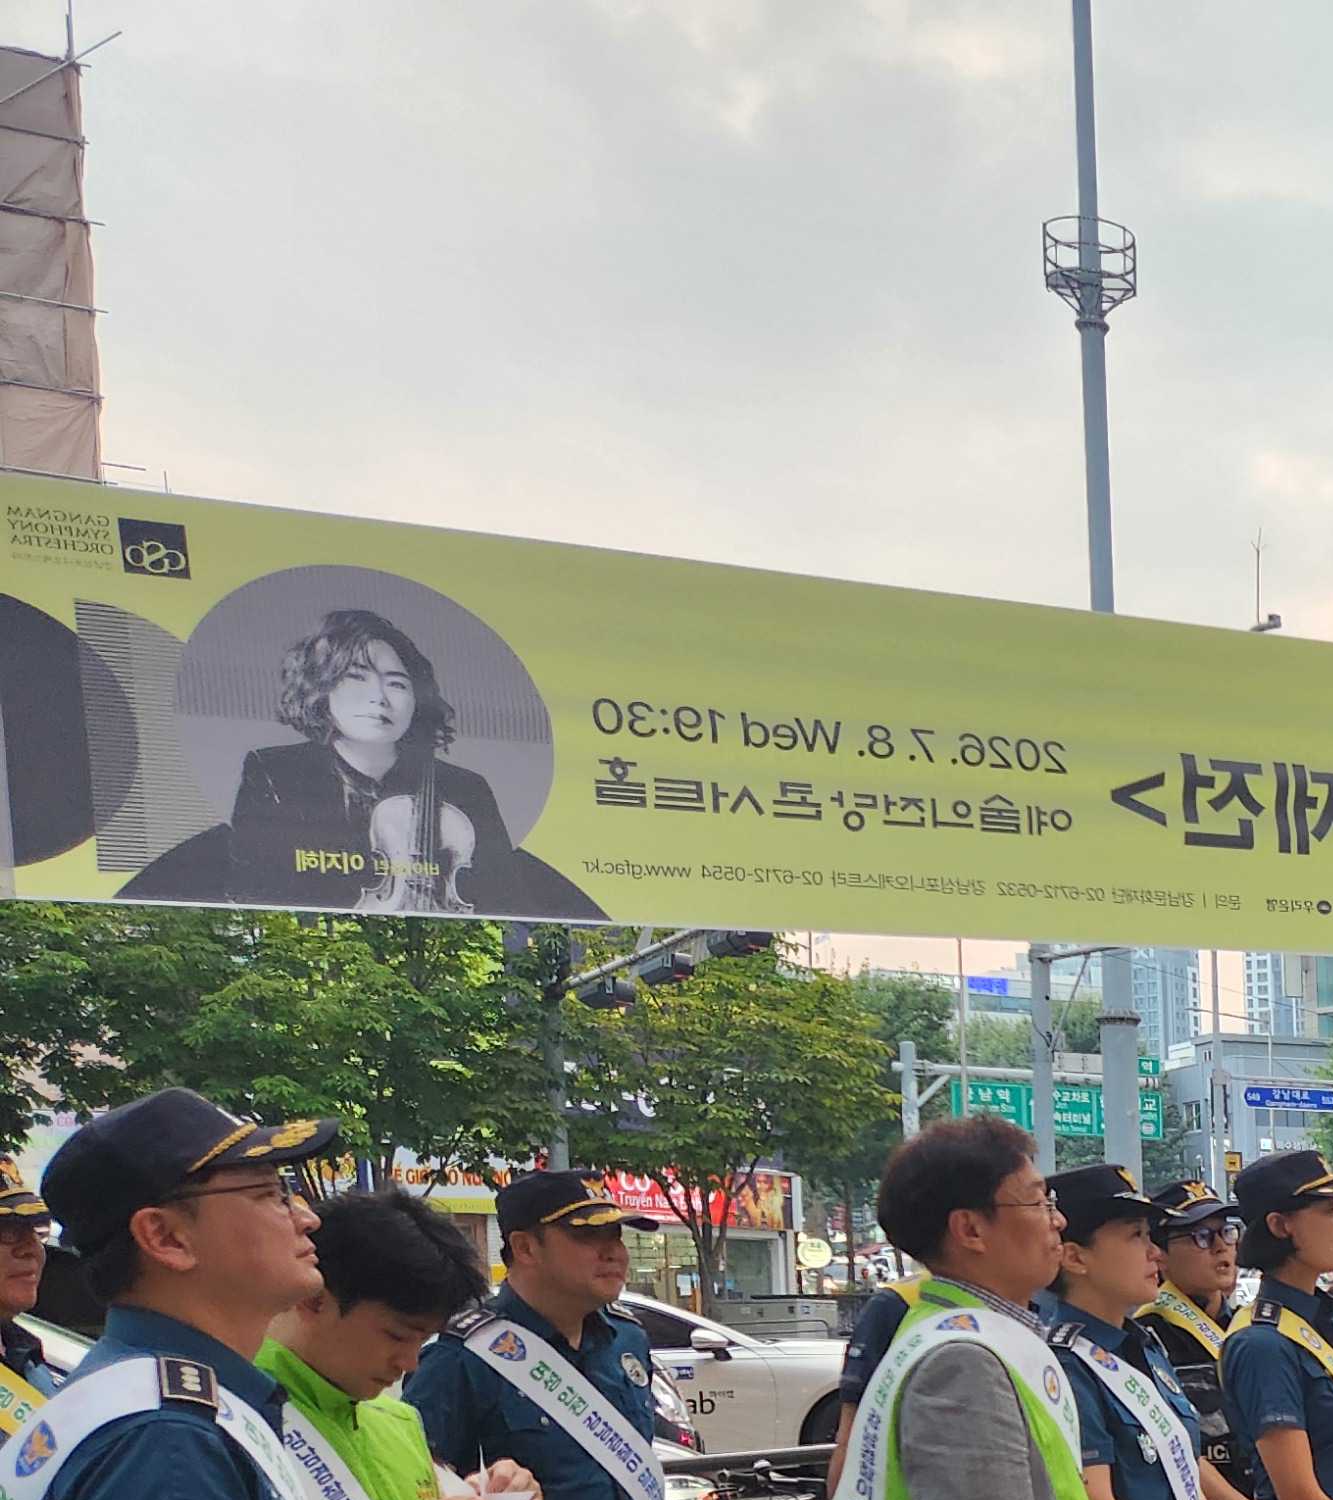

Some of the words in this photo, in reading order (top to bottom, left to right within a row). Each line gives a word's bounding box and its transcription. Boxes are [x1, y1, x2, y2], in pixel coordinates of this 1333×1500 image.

[1272, 1089, 1311, 1100] 강남대로
[529, 1360, 562, 1392] 여성
[557, 1385, 589, 1417] 안전
[583, 1411, 643, 1473] 강남경찰이
